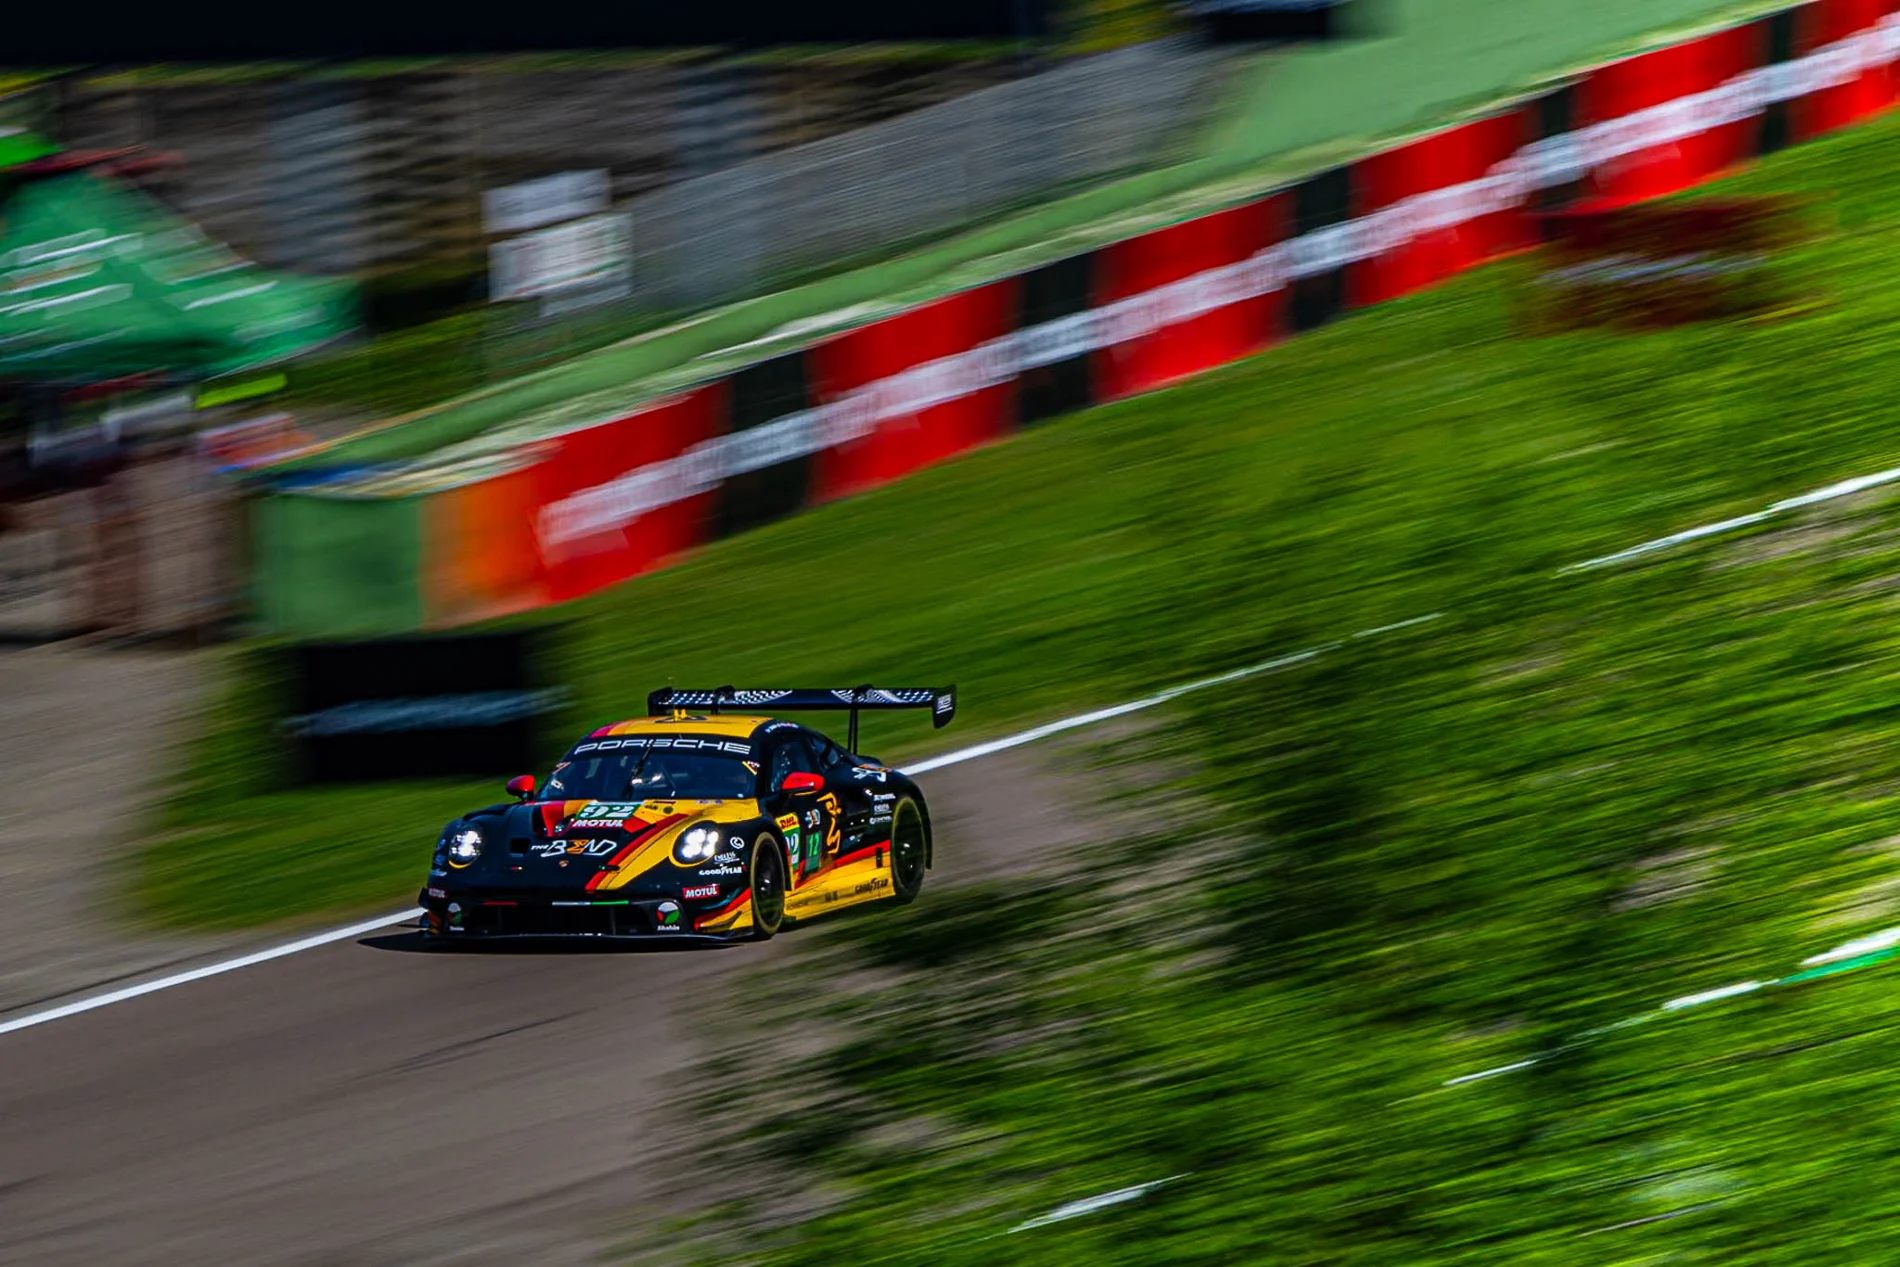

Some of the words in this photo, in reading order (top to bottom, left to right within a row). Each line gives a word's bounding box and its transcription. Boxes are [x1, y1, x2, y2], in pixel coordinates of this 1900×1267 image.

[574, 739, 752, 755] PORSCHE
[579, 805, 635, 818] 92
[685, 884, 718, 898] MOTUL
